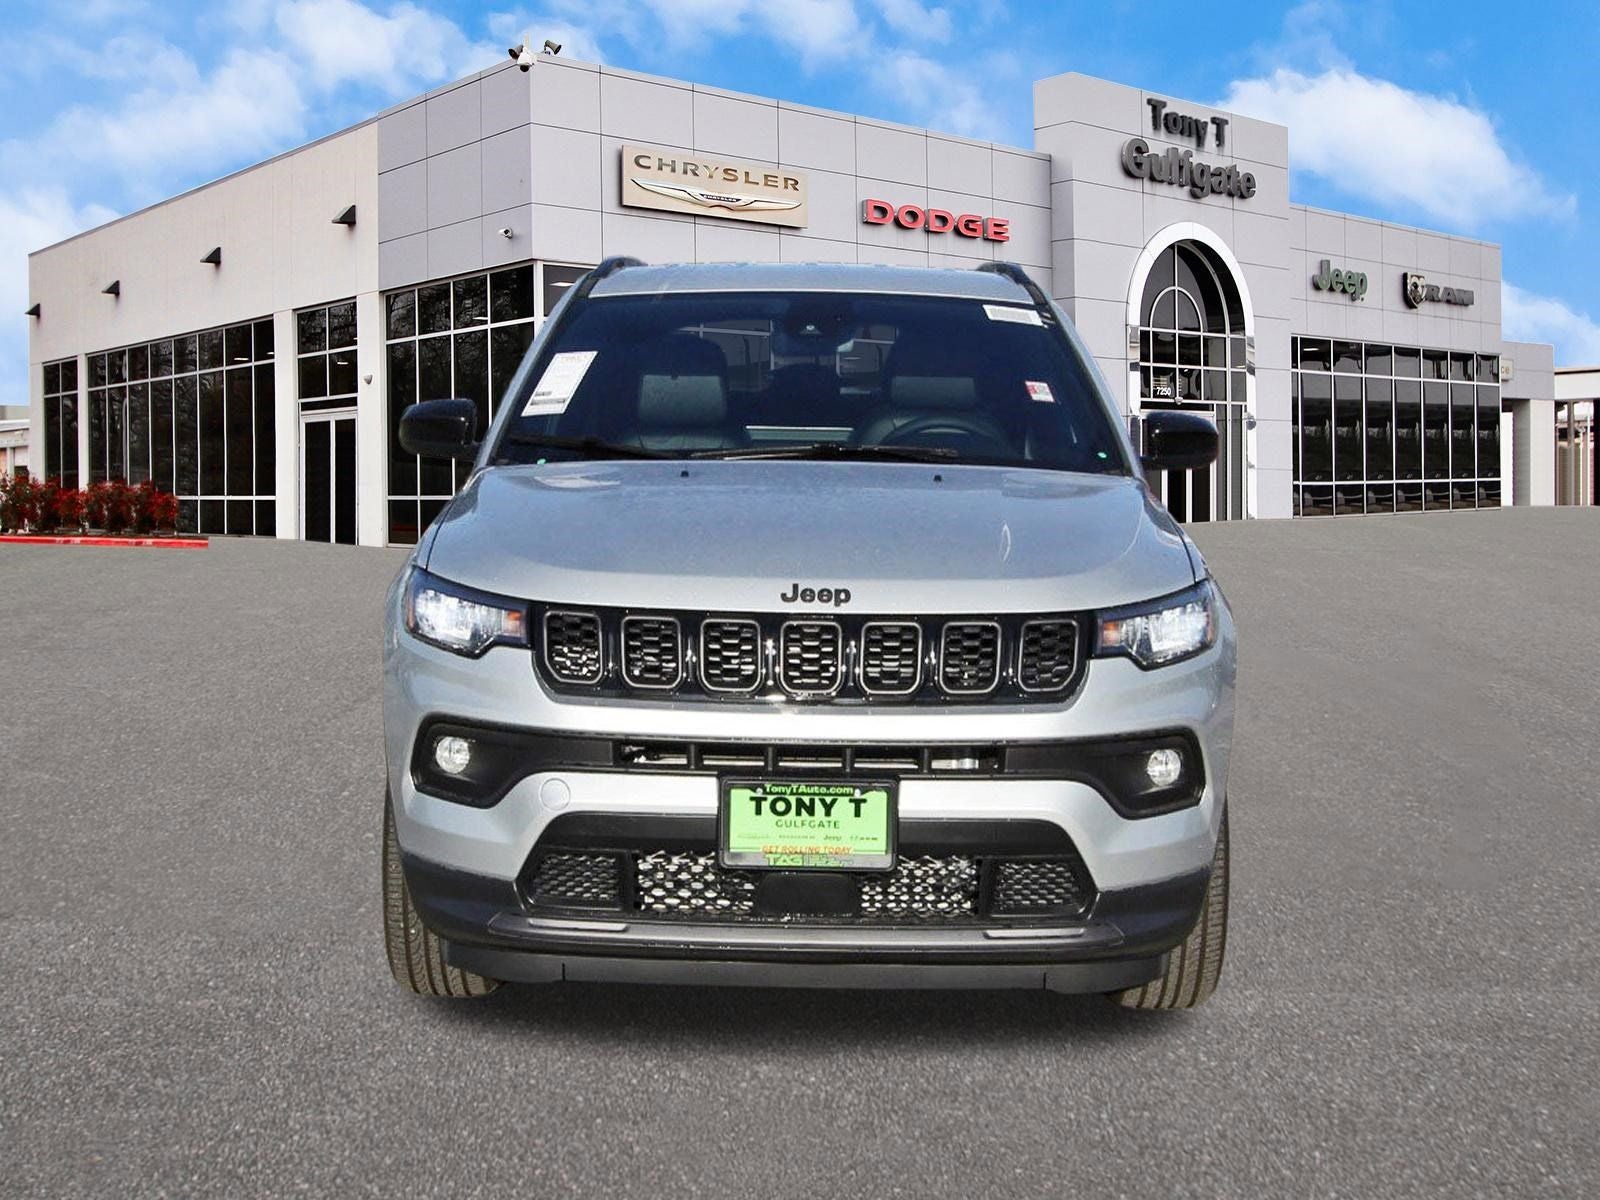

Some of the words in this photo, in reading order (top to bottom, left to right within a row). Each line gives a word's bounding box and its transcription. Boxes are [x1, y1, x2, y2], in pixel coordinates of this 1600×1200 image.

[1146, 98, 1208, 148] Tony
[1211, 117, 1229, 147] T
[633, 154, 800, 192] CHRYSLER
[1121, 138, 1256, 199] Gulfgate
[862, 198, 1011, 242] DODGE
[1312, 259, 1368, 301] Jeep
[1425, 284, 1475, 306] RAM
[1156, 387, 1171, 396] 7250
[780, 583, 852, 607] Jeep
[765, 784, 853, 795] TonyTAuto.com
[750, 796, 838, 817] TONY
[848, 798, 868, 818] T
[775, 819, 840, 829] GULFGATE
